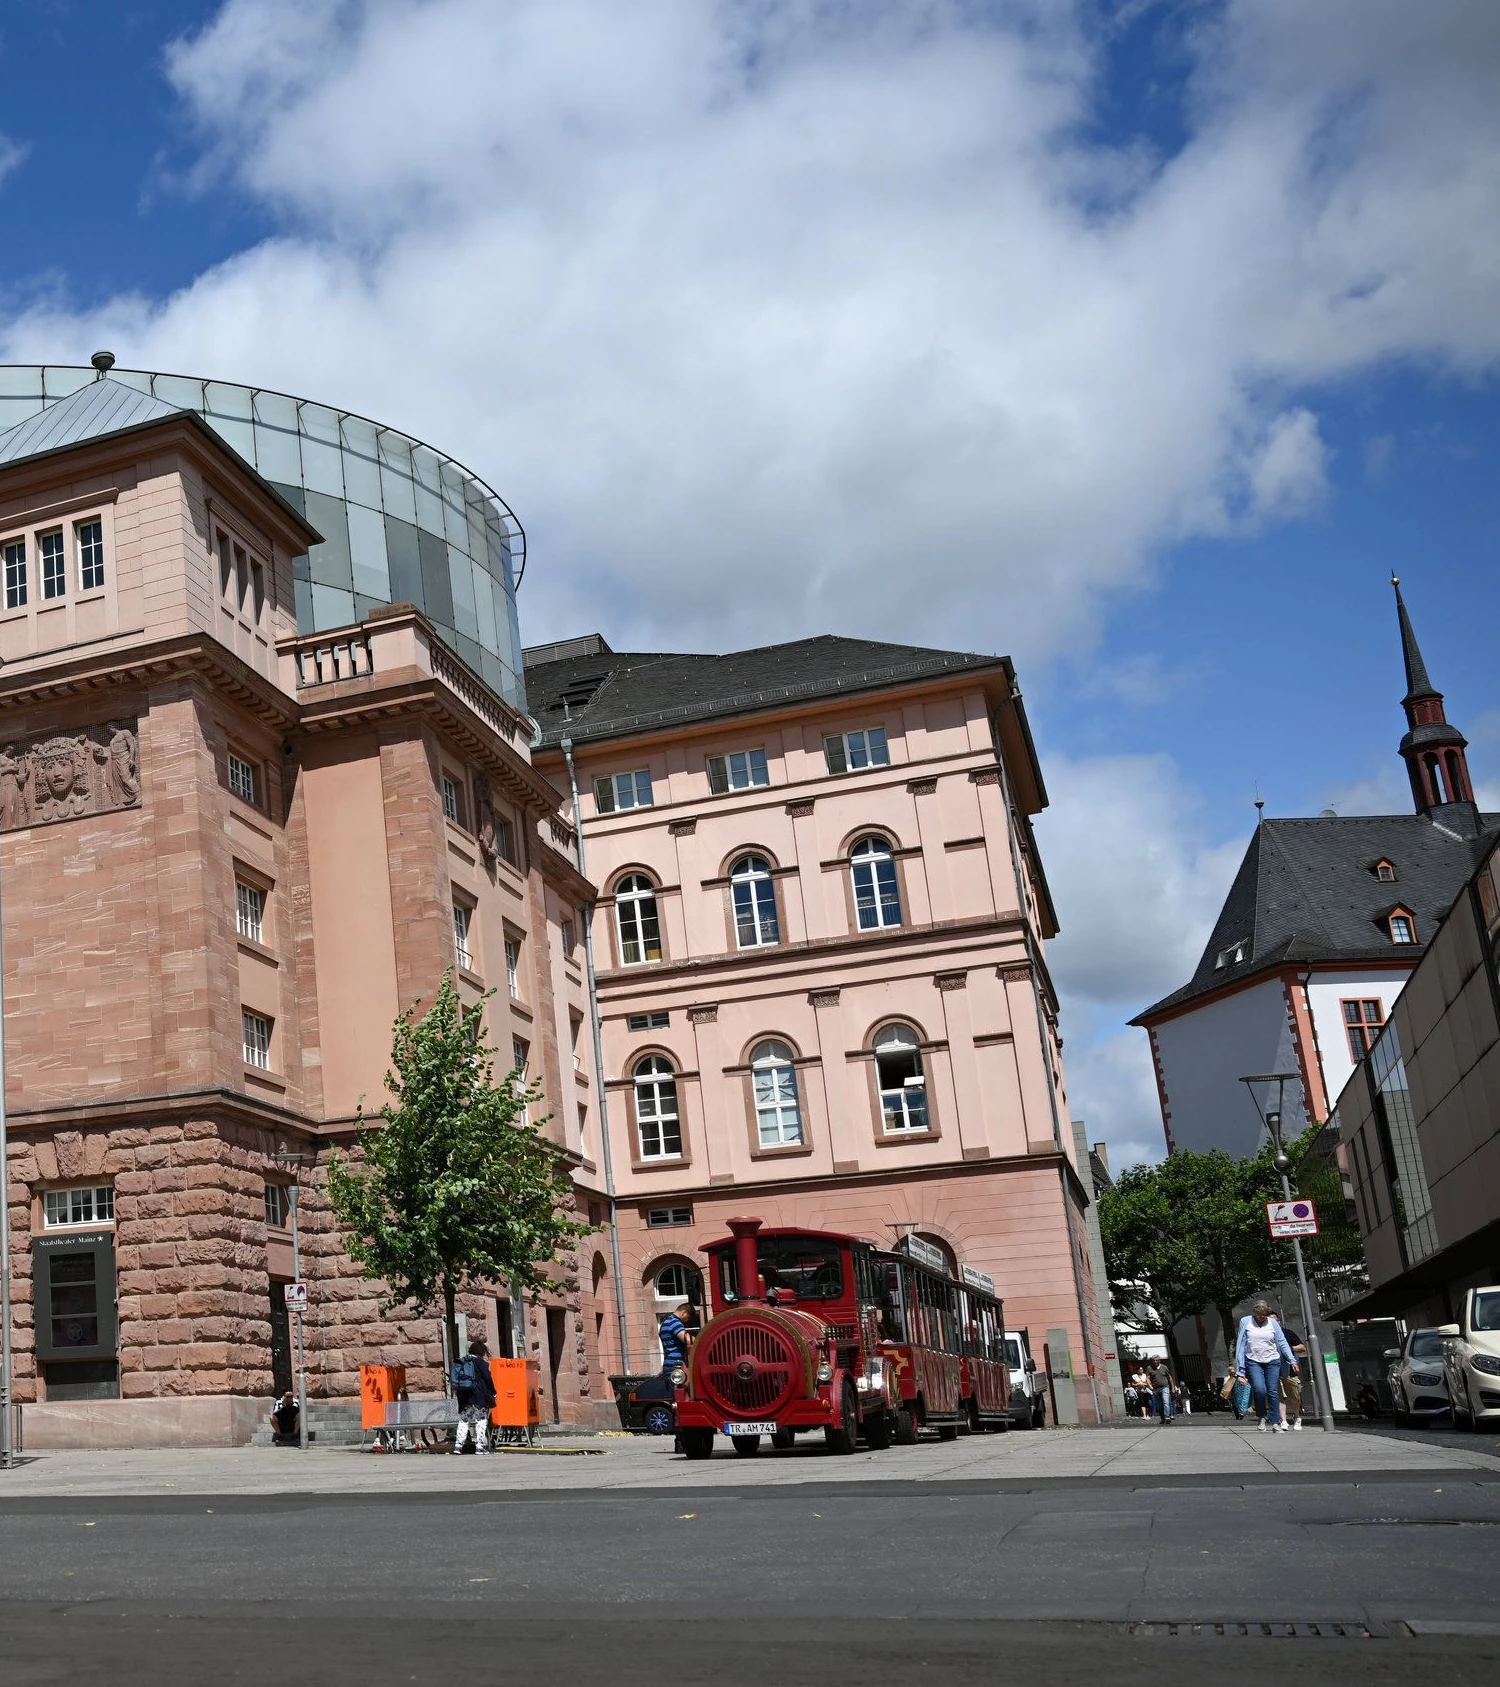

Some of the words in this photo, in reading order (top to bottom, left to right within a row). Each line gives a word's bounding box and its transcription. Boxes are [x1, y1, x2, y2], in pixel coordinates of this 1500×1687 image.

[40, 1238, 75, 1246] Staatstheater
[730, 1425, 741, 1433] TR
[760, 1424, 775, 1432] 741
